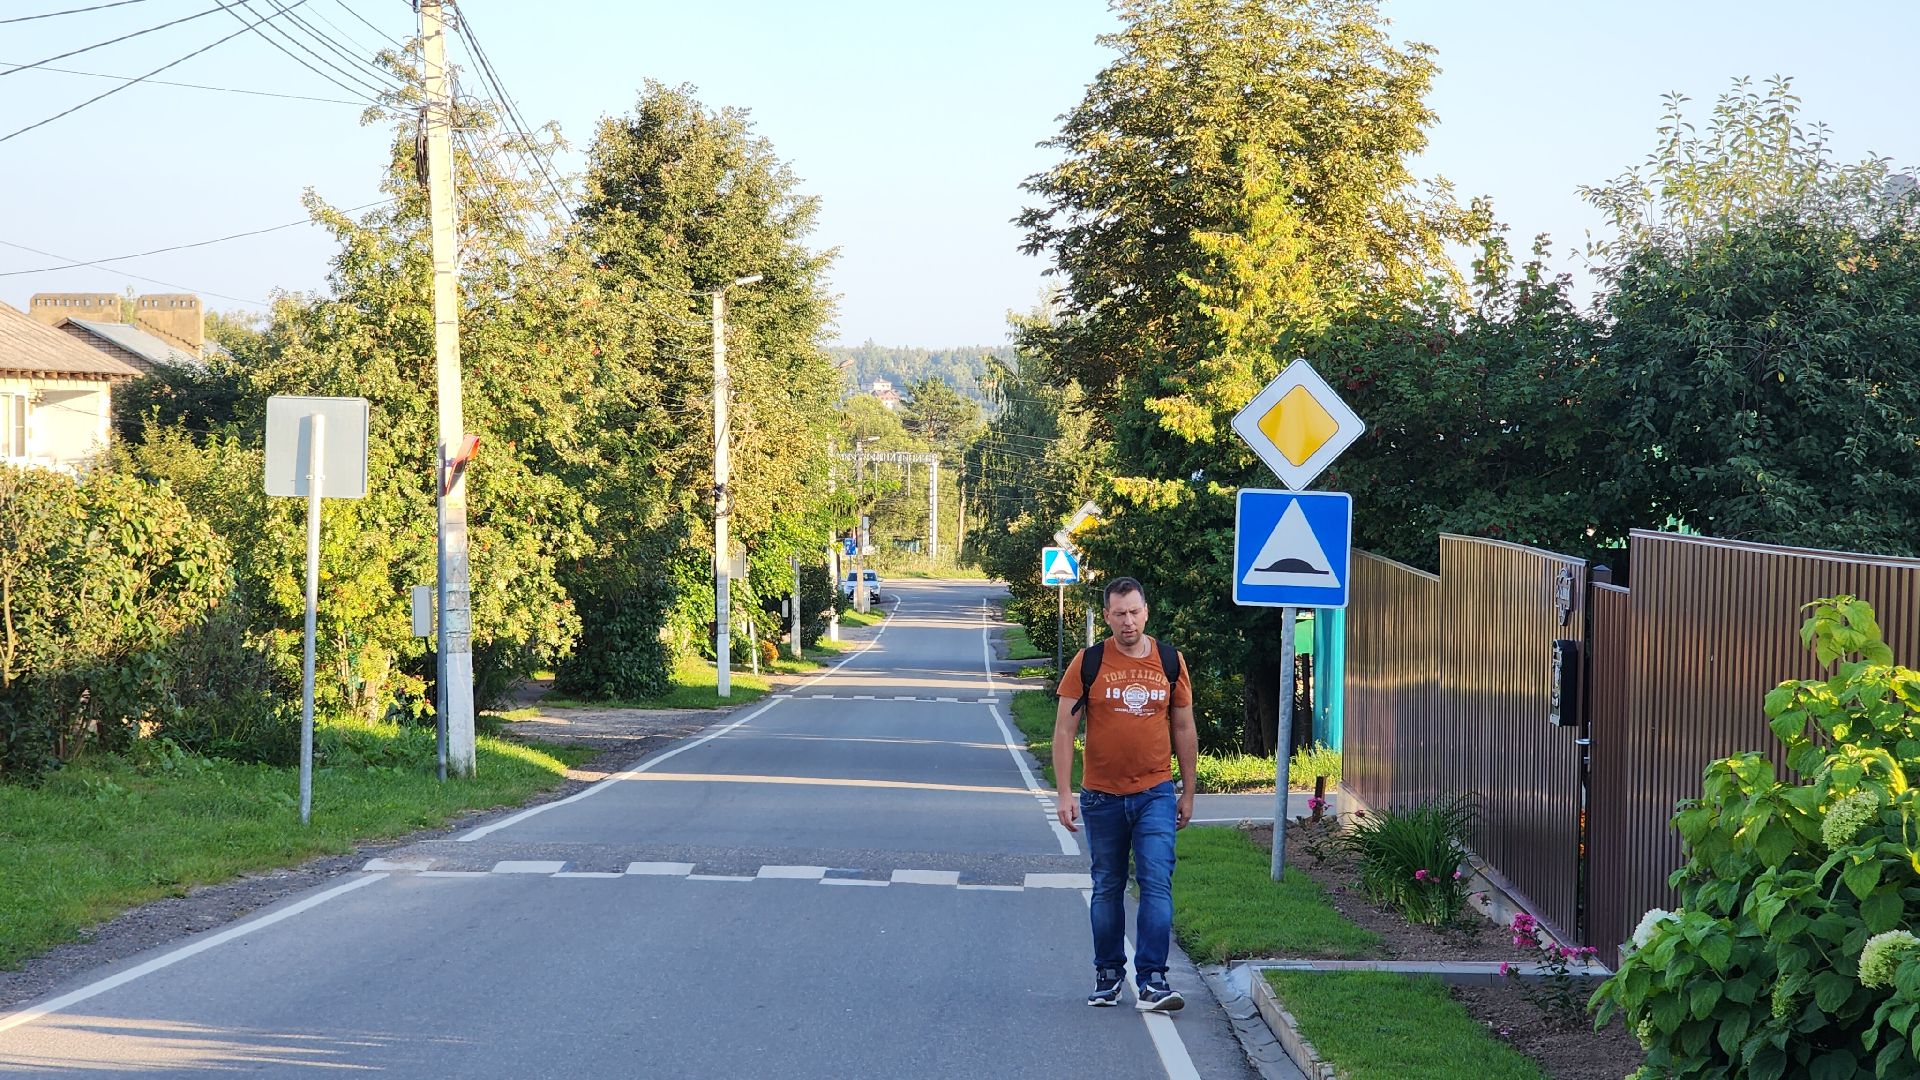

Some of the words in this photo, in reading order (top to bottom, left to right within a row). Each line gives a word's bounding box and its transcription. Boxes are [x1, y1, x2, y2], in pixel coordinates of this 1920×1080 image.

[1103, 671, 1126, 683] TOM
[1130, 669, 1167, 686] TAILOR
[1105, 687, 1121, 699] 19
